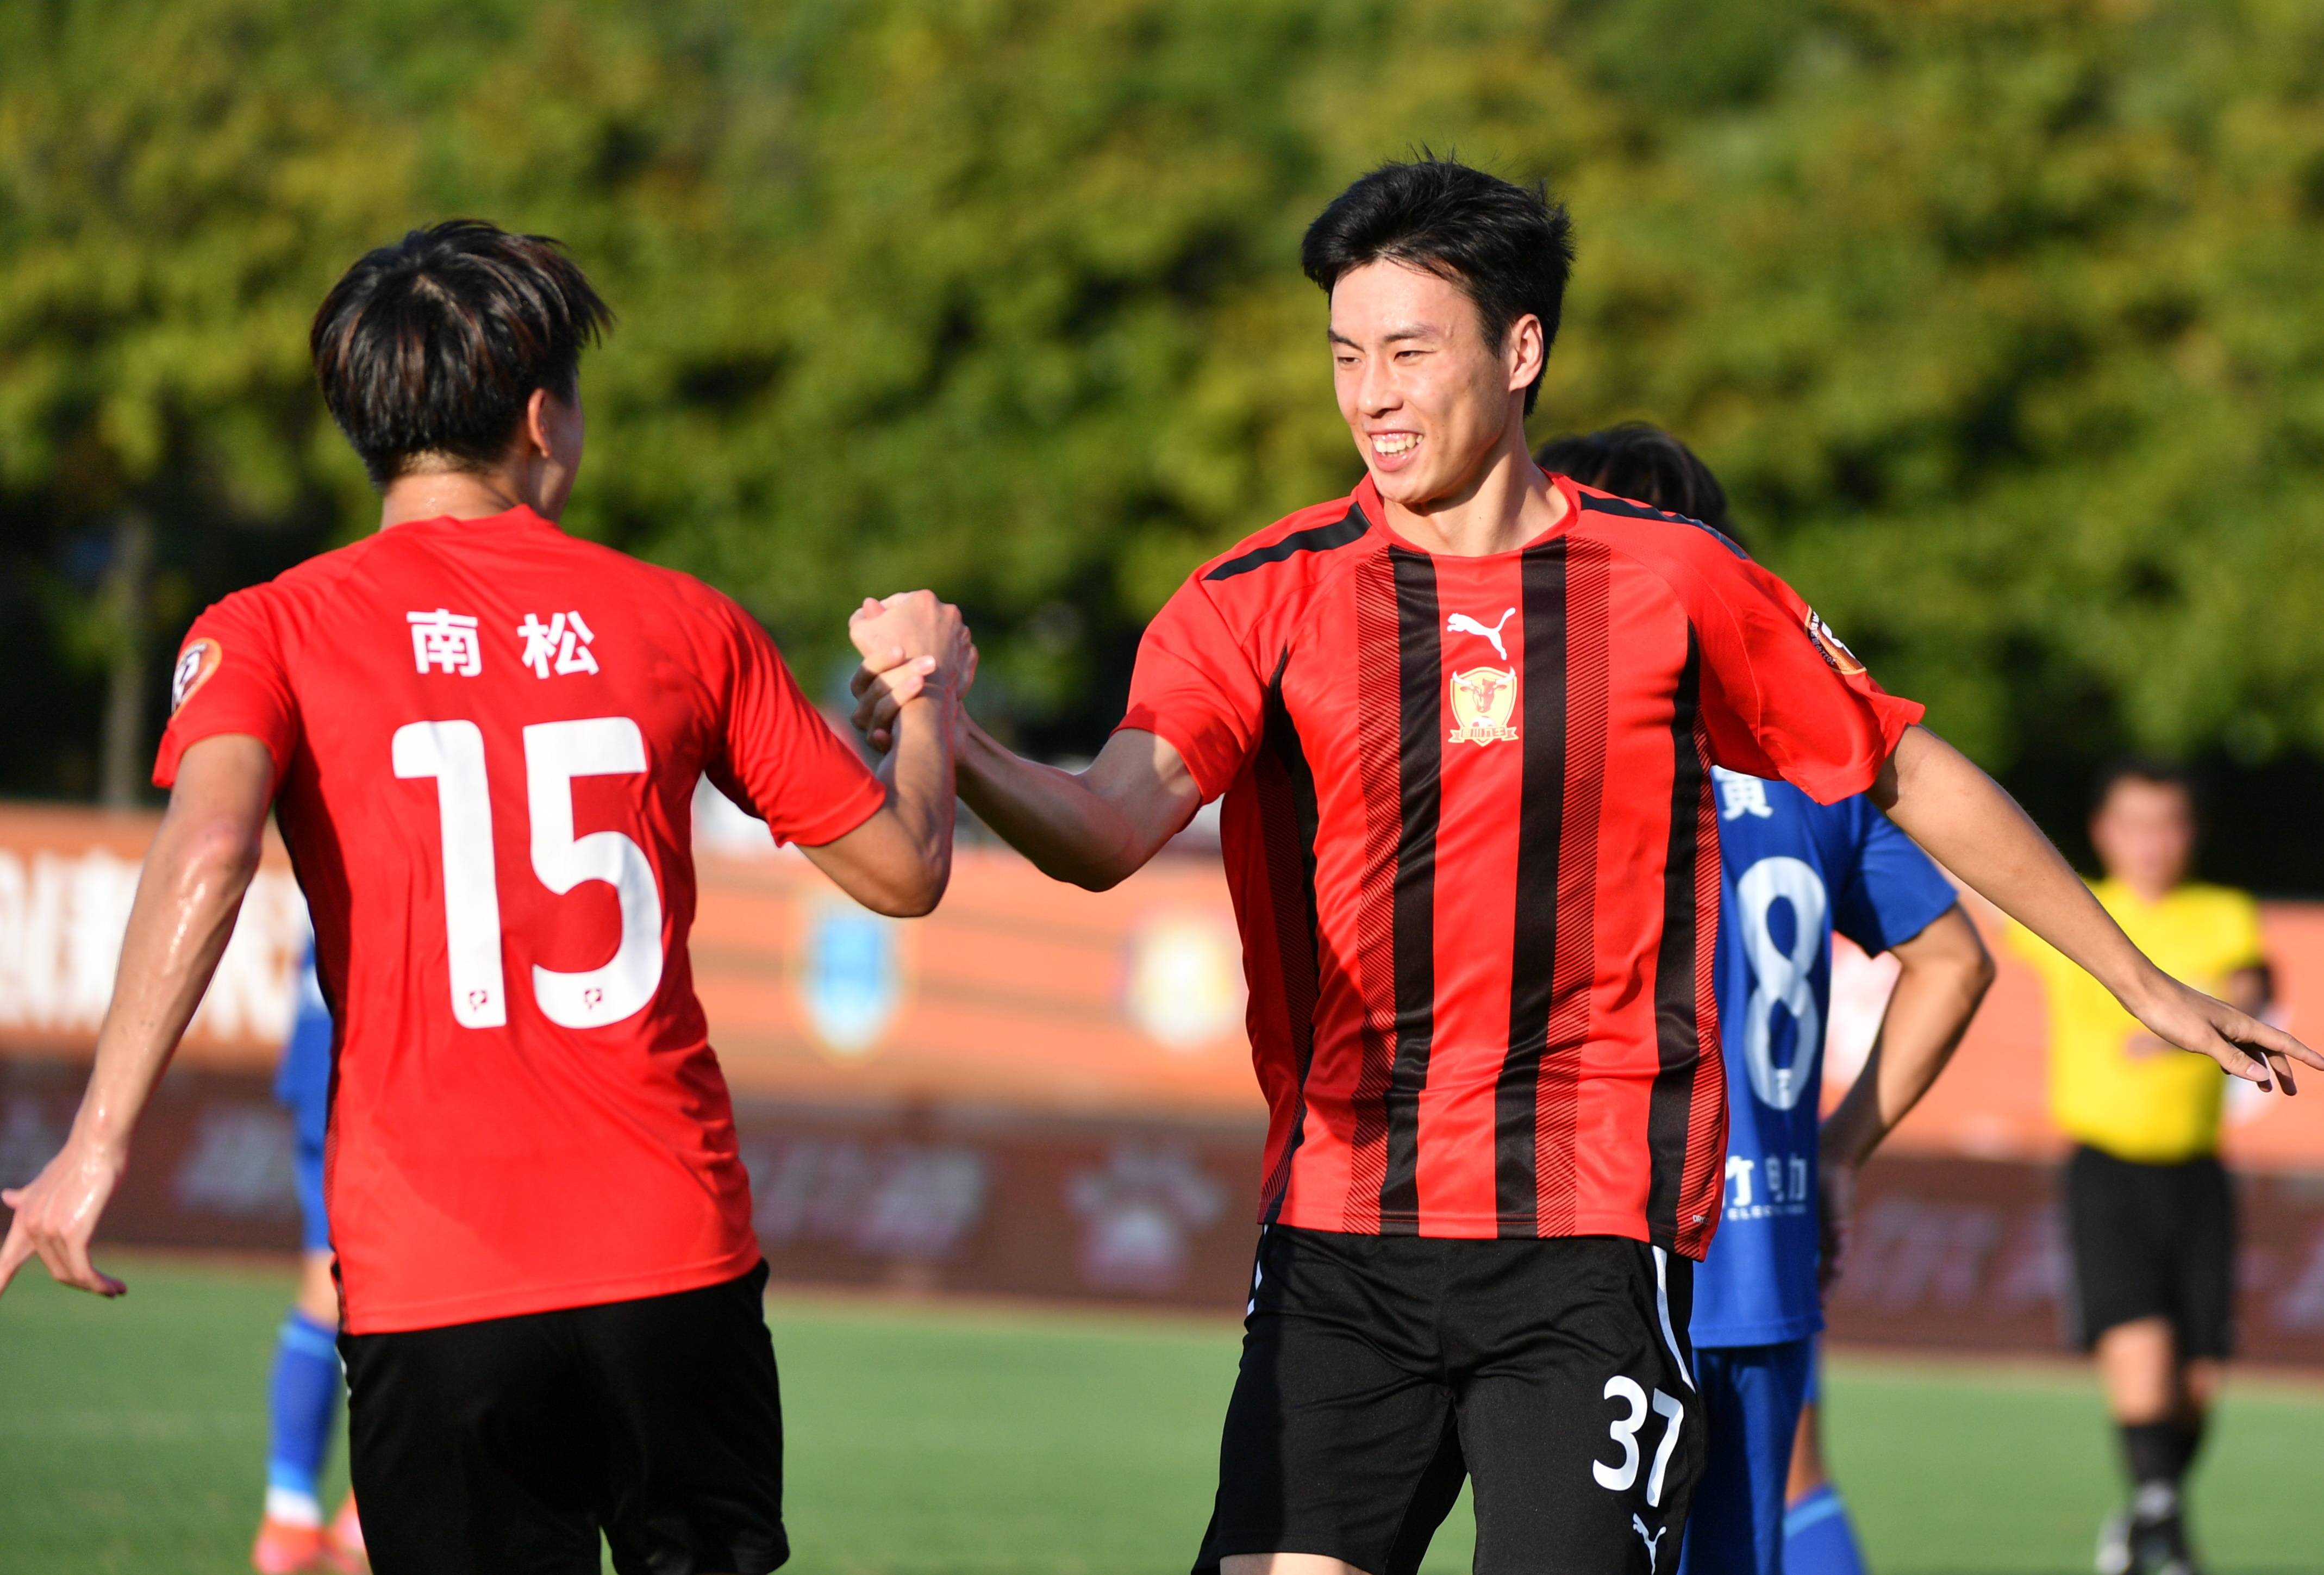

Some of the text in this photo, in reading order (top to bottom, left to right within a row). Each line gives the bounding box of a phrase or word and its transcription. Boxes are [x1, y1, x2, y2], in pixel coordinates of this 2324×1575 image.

[407, 608, 599, 679] 南松
[391, 716, 663, 1029] 15
[1738, 856, 1826, 1110] 8
[1592, 1375, 1684, 1508] 37
